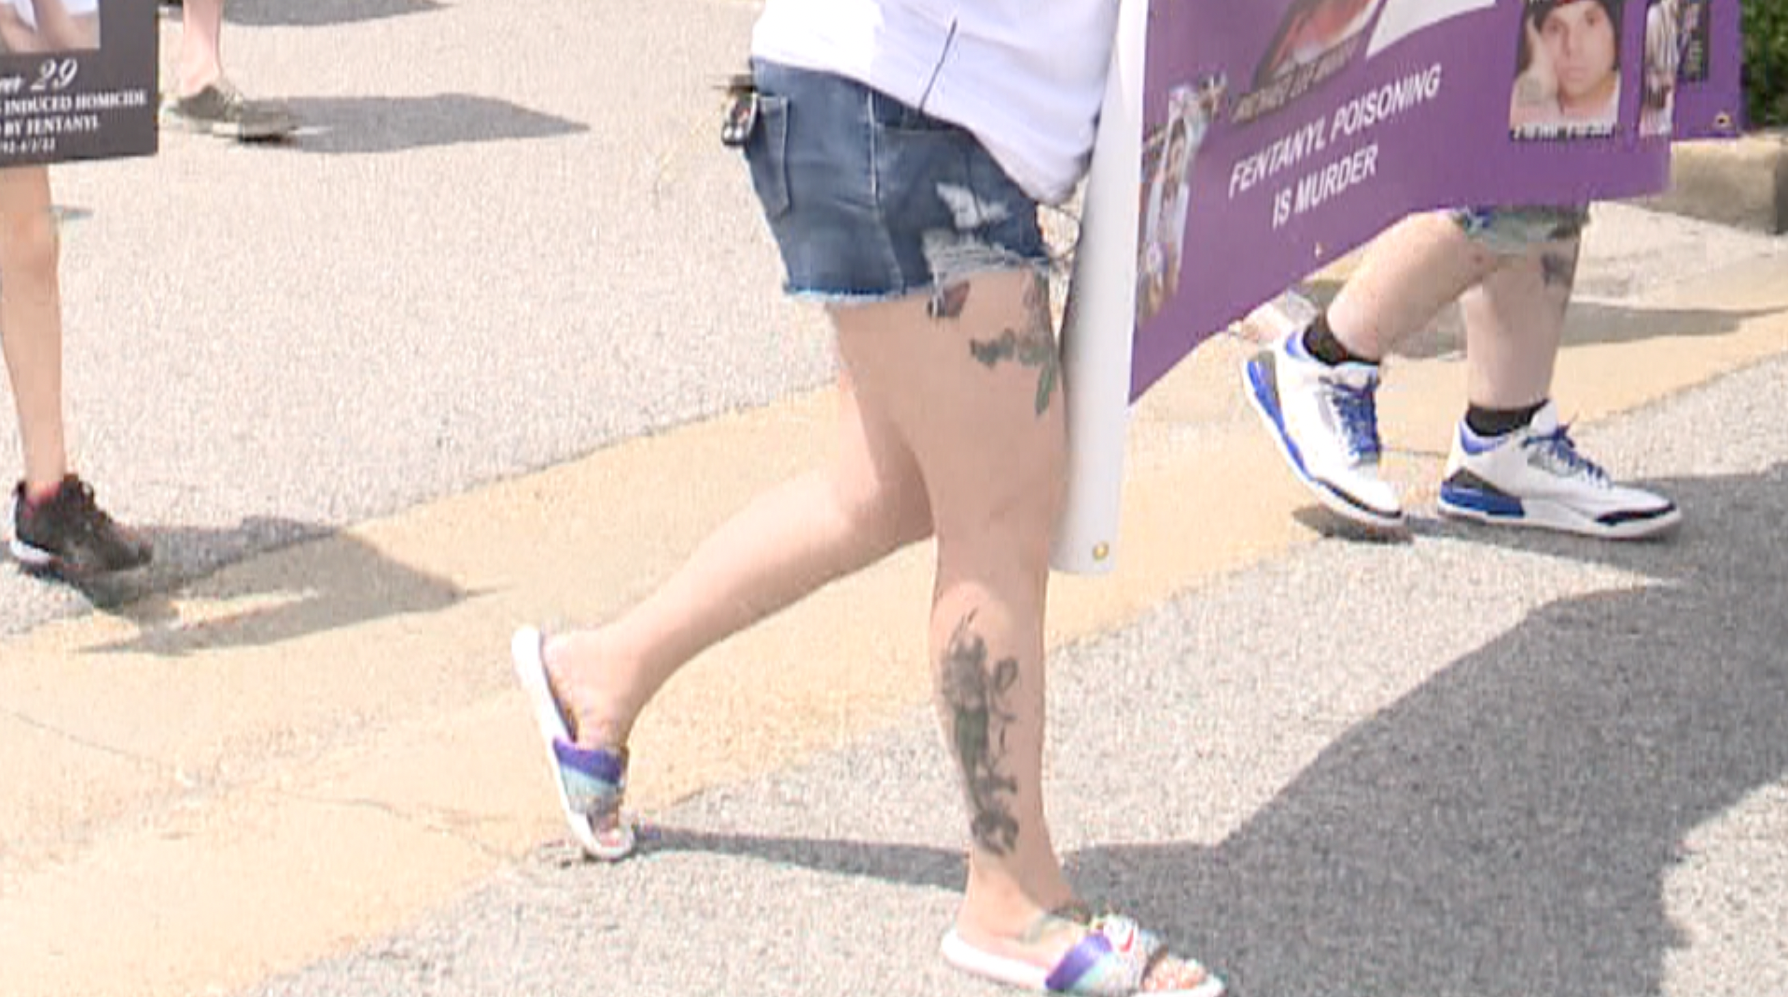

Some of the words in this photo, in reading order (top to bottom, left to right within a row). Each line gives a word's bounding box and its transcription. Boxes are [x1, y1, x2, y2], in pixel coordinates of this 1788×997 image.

[30, 58, 78, 91] 29
[4, 95, 73, 116] INDUCED
[75, 90, 147, 109] HOMICIDE
[3, 121, 23, 136] BY
[27, 114, 100, 134] FENTANYL
[1227, 115, 1326, 201] FENTANYL
[1329, 62, 1442, 144] POISONING
[1273, 187, 1292, 231] IS
[1294, 142, 1379, 214] MURDER
